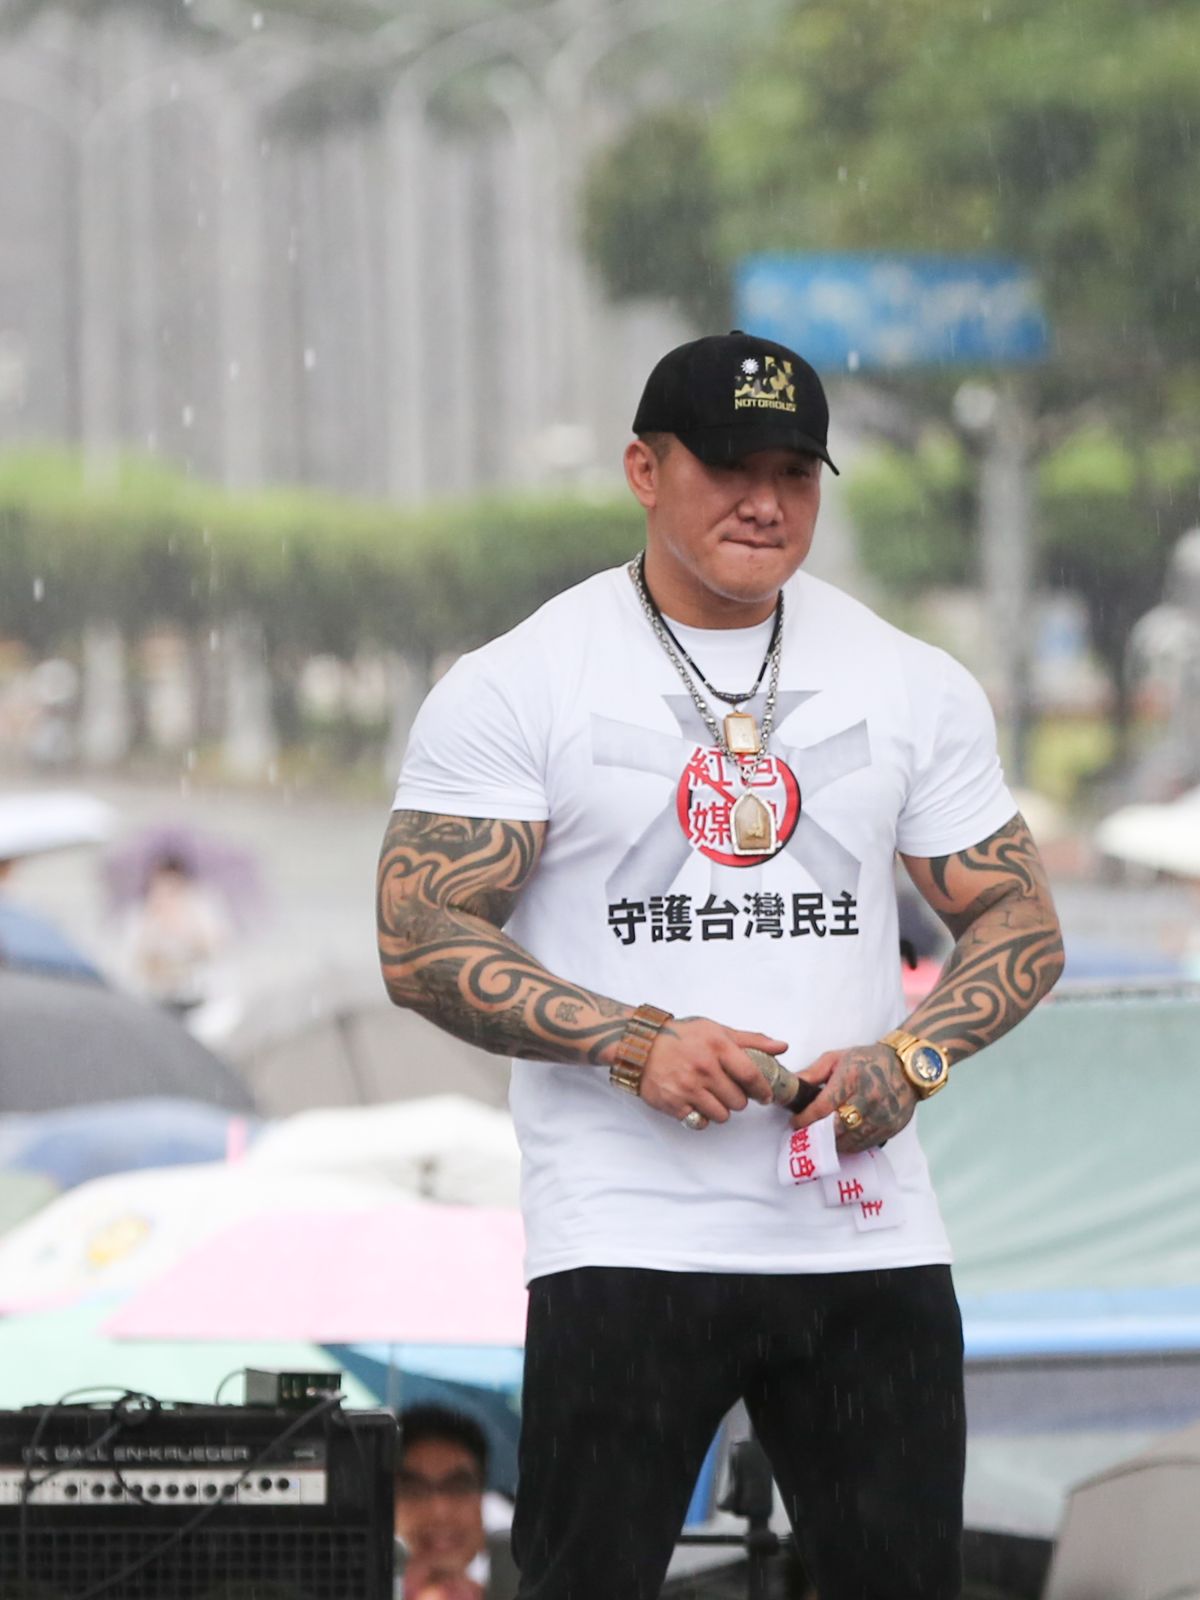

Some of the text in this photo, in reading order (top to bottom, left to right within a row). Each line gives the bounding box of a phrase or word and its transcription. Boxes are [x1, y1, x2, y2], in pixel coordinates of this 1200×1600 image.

[734, 398, 796, 412] NOTORIOUS
[689, 801, 778, 845] 媒
[607, 890, 860, 946] 守護台灣民主
